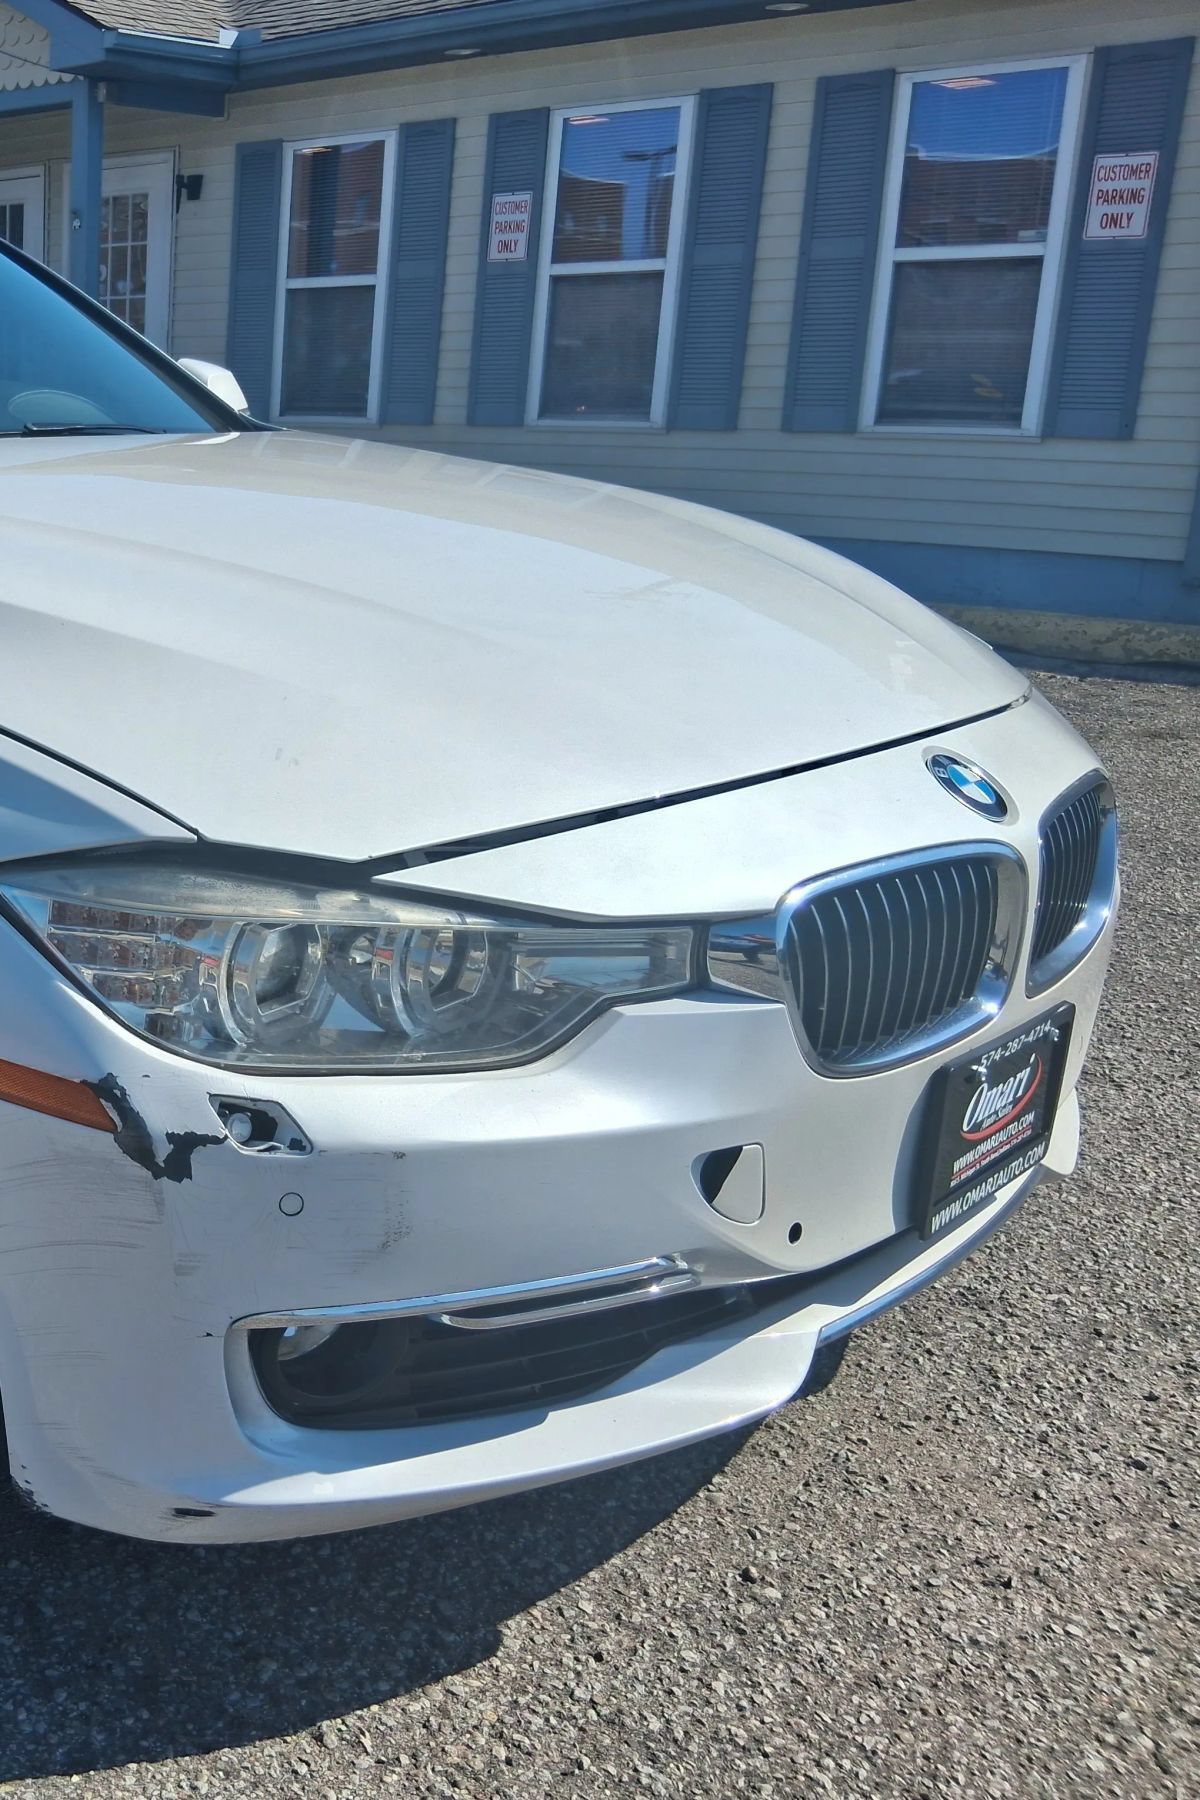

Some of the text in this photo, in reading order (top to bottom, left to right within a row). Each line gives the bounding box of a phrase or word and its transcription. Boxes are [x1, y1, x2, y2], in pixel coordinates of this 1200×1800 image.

[1097, 163, 1152, 182] CUSTOMER
[1096, 188, 1146, 206] PARKING
[495, 200, 529, 216] CUSTOMER
[495, 220, 526, 235] PARKING
[1100, 212, 1134, 230] ONLY
[497, 239, 519, 254] ONLY
[980, 1020, 1051, 1070] 574-287-4714
[963, 1053, 1036, 1132] Omari
[953, 1111, 1035, 1174] WWW.OMARIAUTO.COM
[931, 1142, 1046, 1234] WWW.OMARIAUTO.COM
